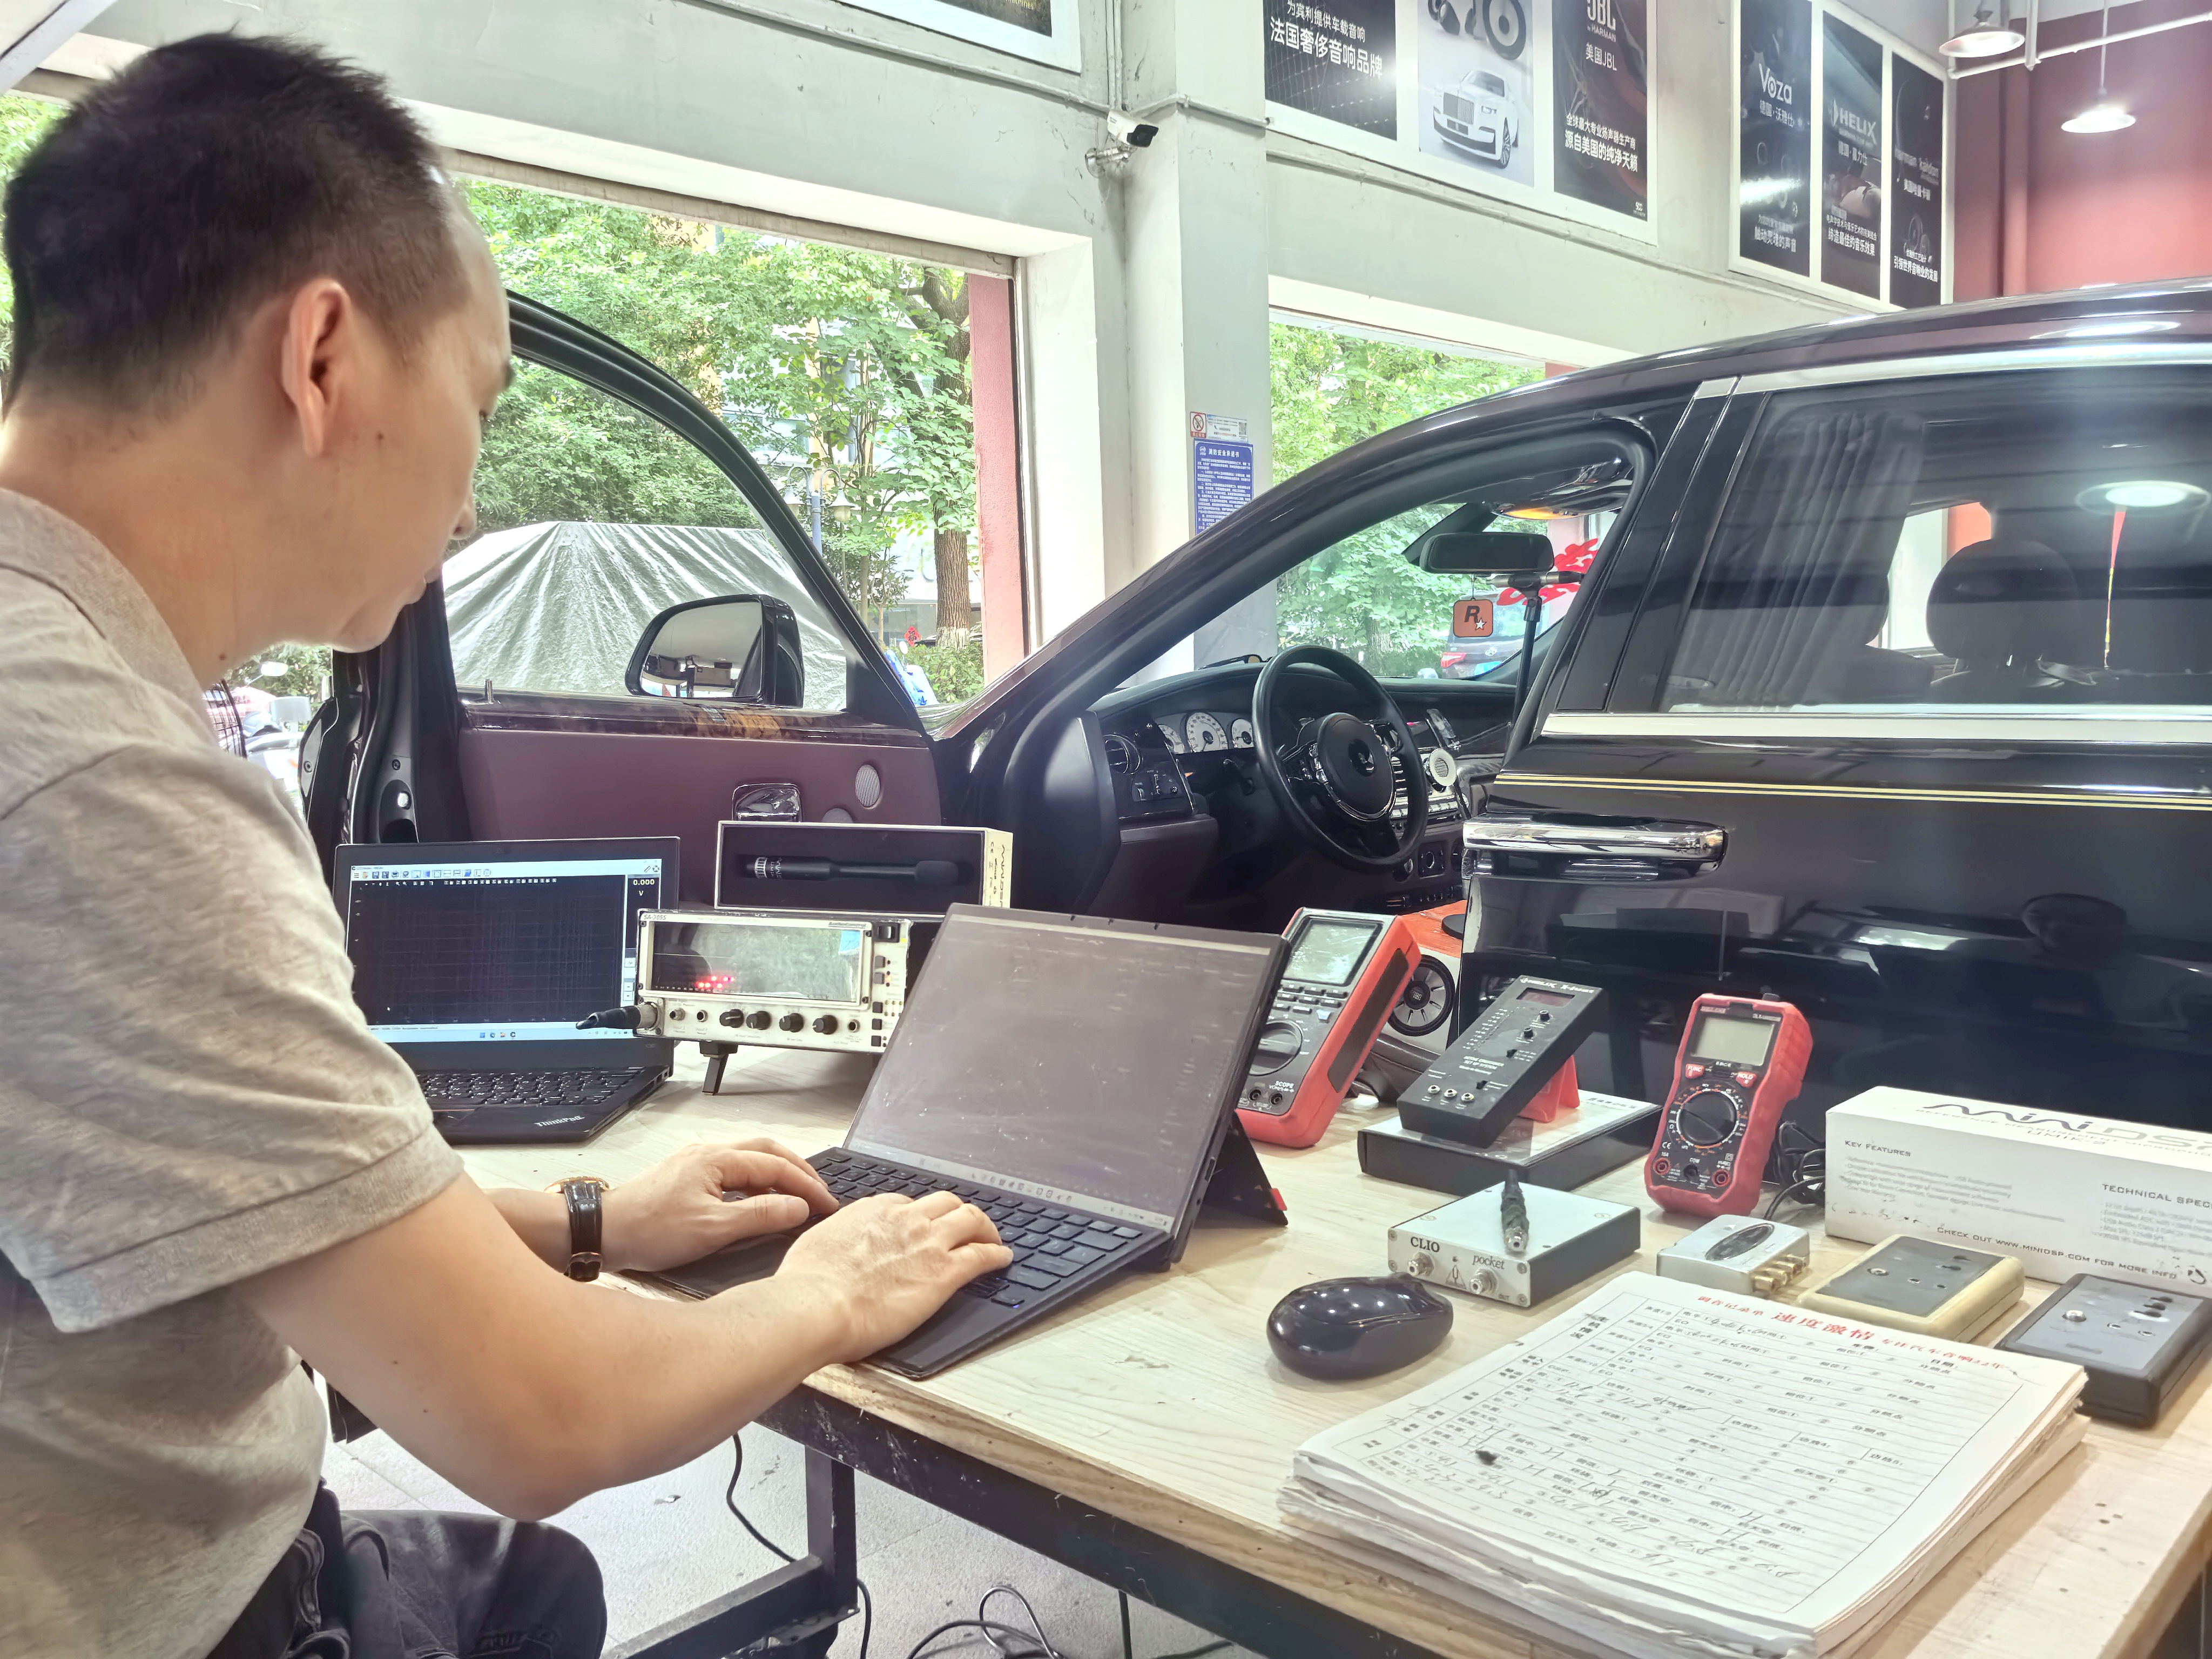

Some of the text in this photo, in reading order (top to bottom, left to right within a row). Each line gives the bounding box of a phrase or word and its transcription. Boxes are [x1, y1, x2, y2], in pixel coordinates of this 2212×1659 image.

[1287, 0, 1365, 43] 为宾利提供车载音响
[1587, 0, 1616, 31] JBL
[1591, 24, 1616, 42] HARMAN
[1270, 16, 1382, 79] 法国奢侈音响品牌
[1586, 42, 1617, 71] 美国JBL
[1566, 112, 1636, 150] 全球最大专业扬声器生产商
[1839, 107, 1877, 145] HELIX
[1565, 129, 1638, 172] 源自美国的纯净天籁
[1464, 605, 1480, 624] R
[534, 1115, 585, 1127] ThinkPad
[1866, 1144, 1911, 1157] FEATURES
[2102, 1184, 2212, 1209] TECHNICAL SPEC
[1411, 1237, 1440, 1252] CLIO
[1937, 1226, 1969, 1238] CHECK
[1973, 1235, 1992, 1244] OUT
[2094, 1259, 2115, 1267] FOR
[2119, 1263, 2148, 1274] MORE
[2152, 1270, 2177, 1279] INFO
[1472, 1255, 1505, 1270] pocket
[1771, 1312, 1875, 1340] 速度激情
